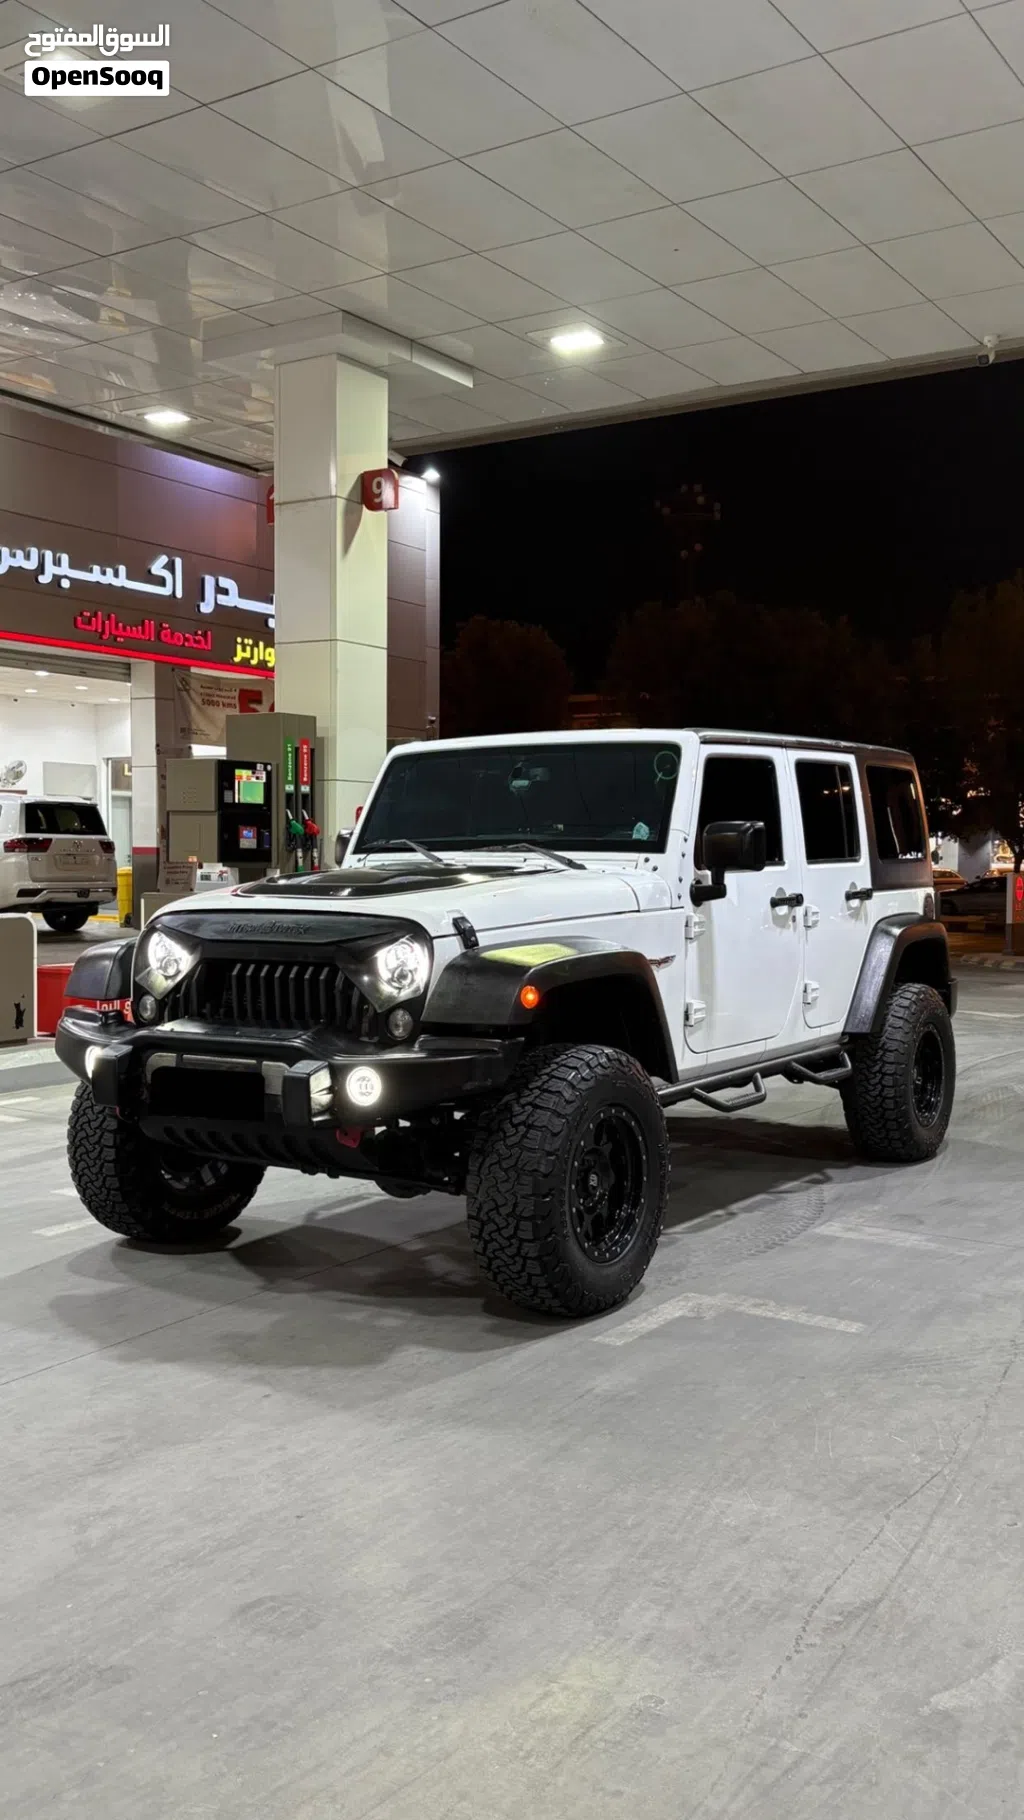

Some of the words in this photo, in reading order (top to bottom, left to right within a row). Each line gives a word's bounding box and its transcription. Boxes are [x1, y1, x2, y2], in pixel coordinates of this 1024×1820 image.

[372, 477, 385, 503] 9
[74, 610, 156, 643] السيارات
[159, 622, 213, 651] لخدمة
[233, 636, 275, 668] وارتز
[201, 698, 220, 708] 5000
